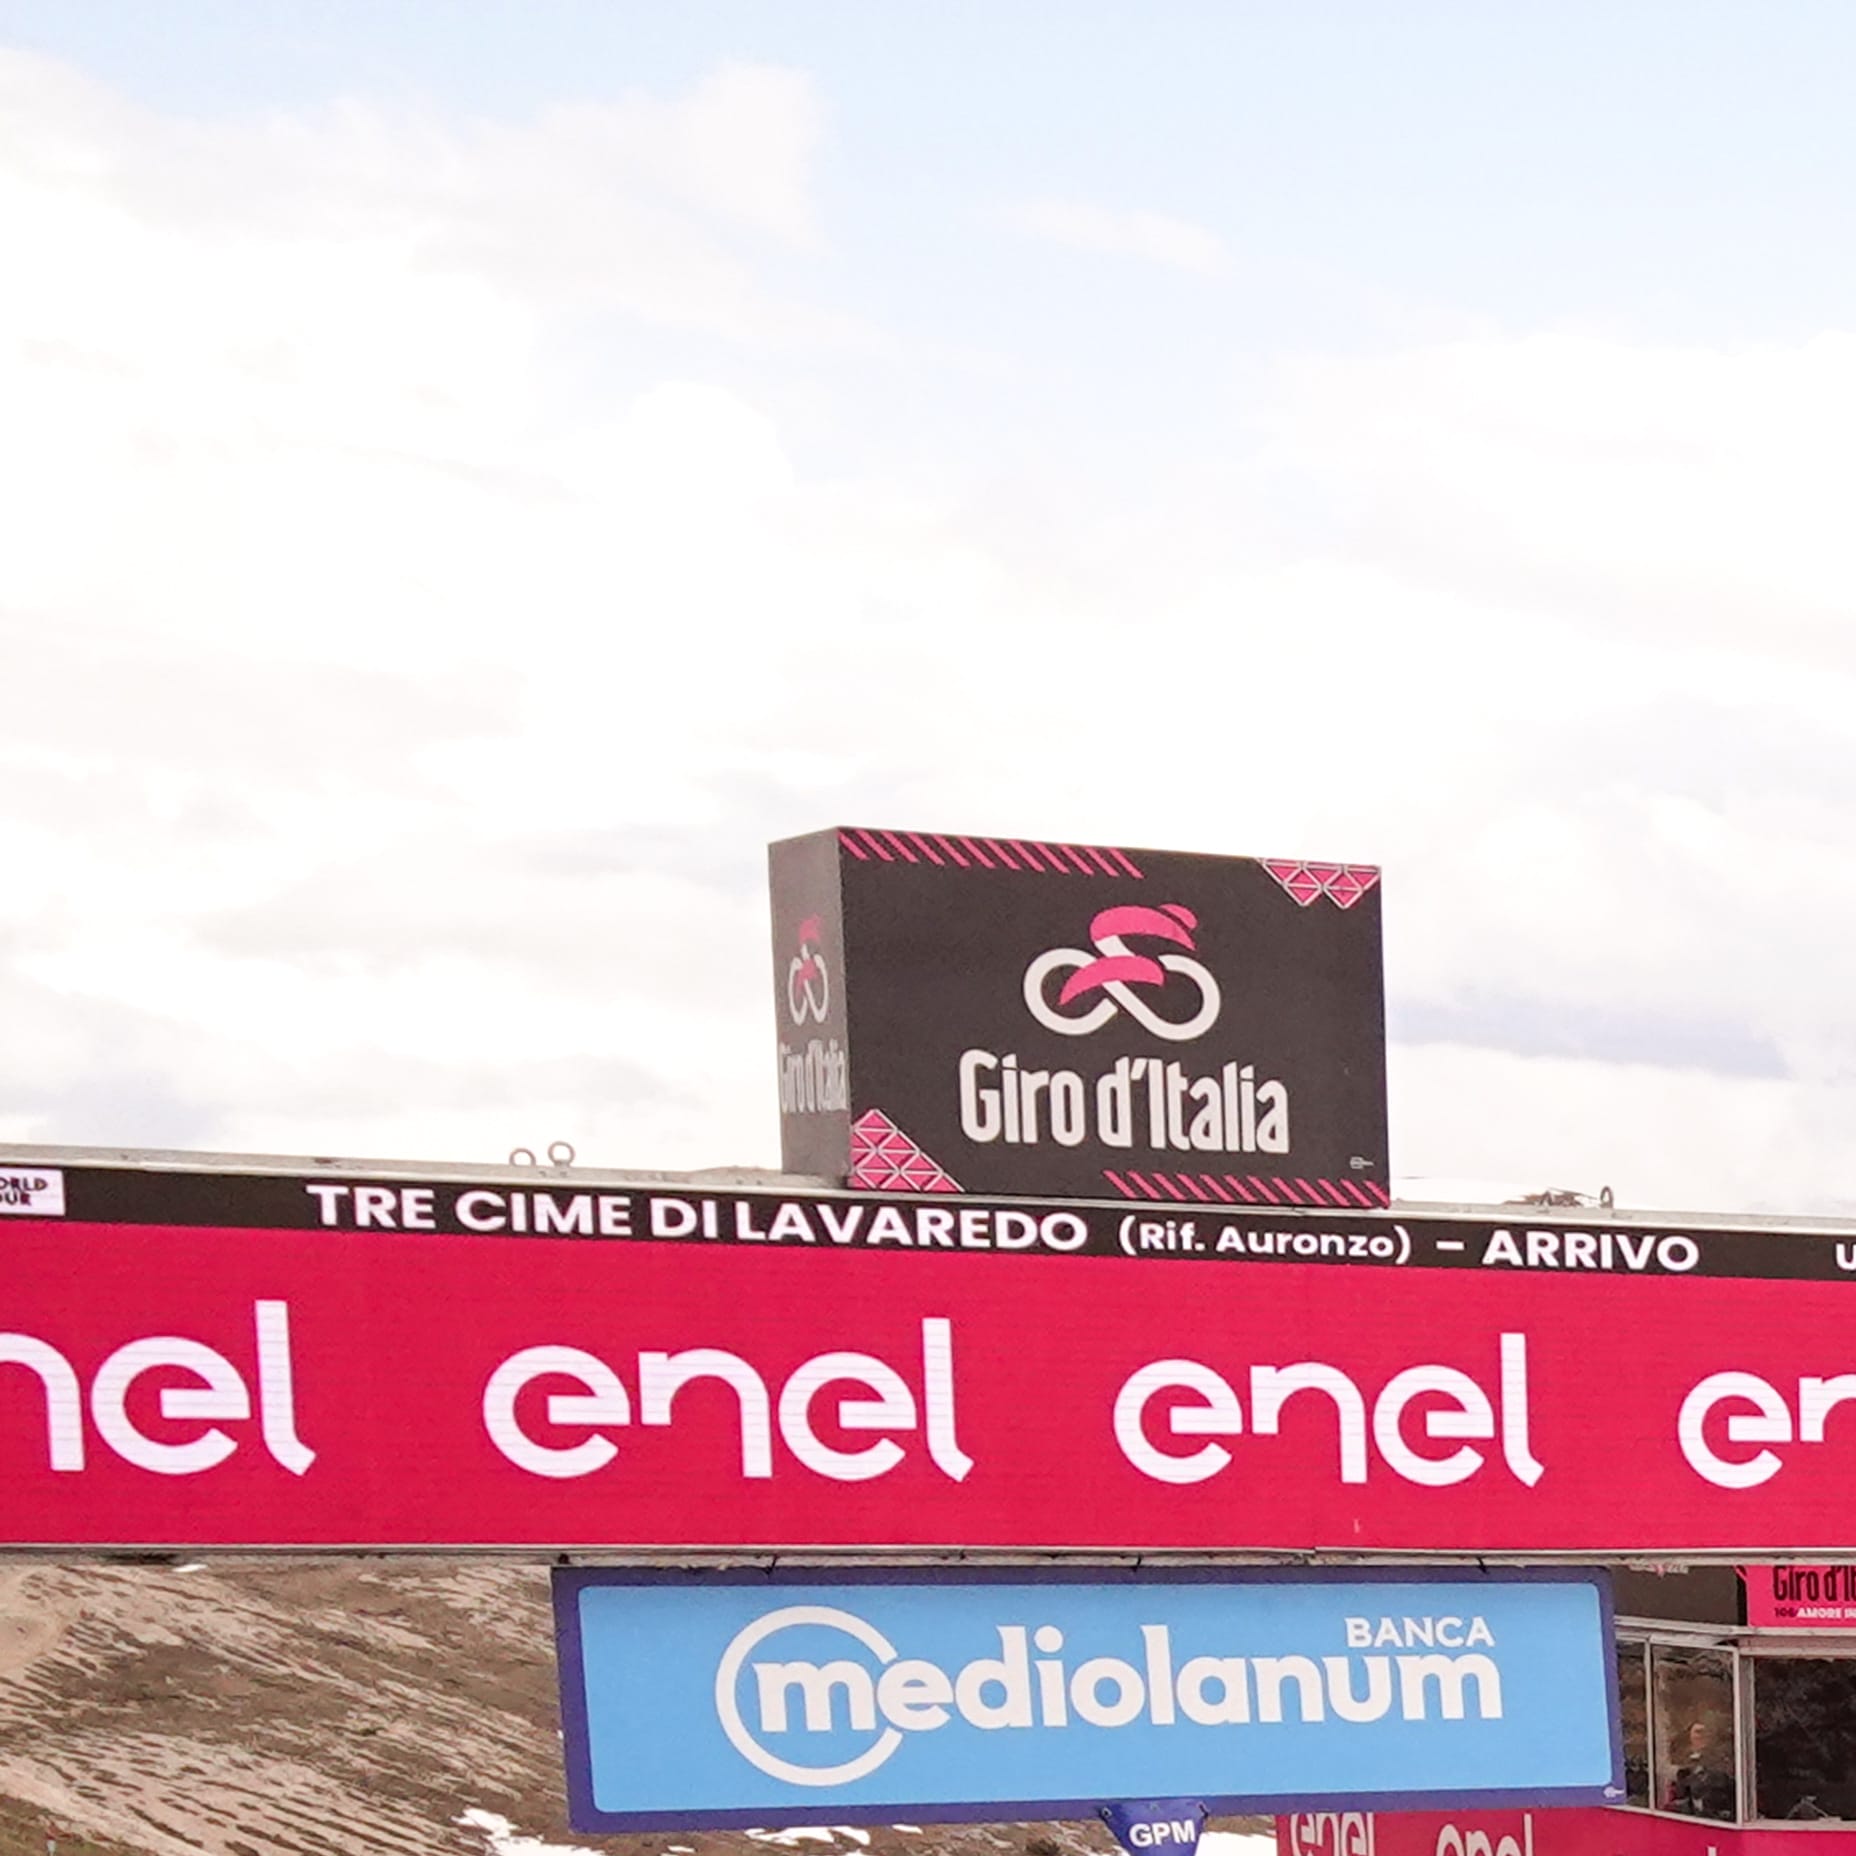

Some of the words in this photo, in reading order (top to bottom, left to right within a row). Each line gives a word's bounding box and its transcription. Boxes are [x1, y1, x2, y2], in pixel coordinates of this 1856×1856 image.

[959, 1049, 1087, 1147] Giro
[1096, 1053, 1290, 1154] d'Italia
[306, 1185, 436, 1229] TRE
[455, 1190, 633, 1237] CIME
[650, 1197, 718, 1239] DI
[734, 1201, 1088, 1250] LAVAREDO
[1118, 1214, 1205, 1255] (Rif.
[1215, 1224, 1411, 1265] Auronzo)
[1482, 1229, 1699, 1272] ARRIVO
[0, 1299, 317, 1476] nel
[483, 1317, 975, 1483] enel
[1113, 1333, 1545, 1489] enel
[753, 1622, 1503, 1733] mediolanum
[1344, 1615, 1496, 1649] BANCA
[1129, 1820, 1196, 1848] GPM
